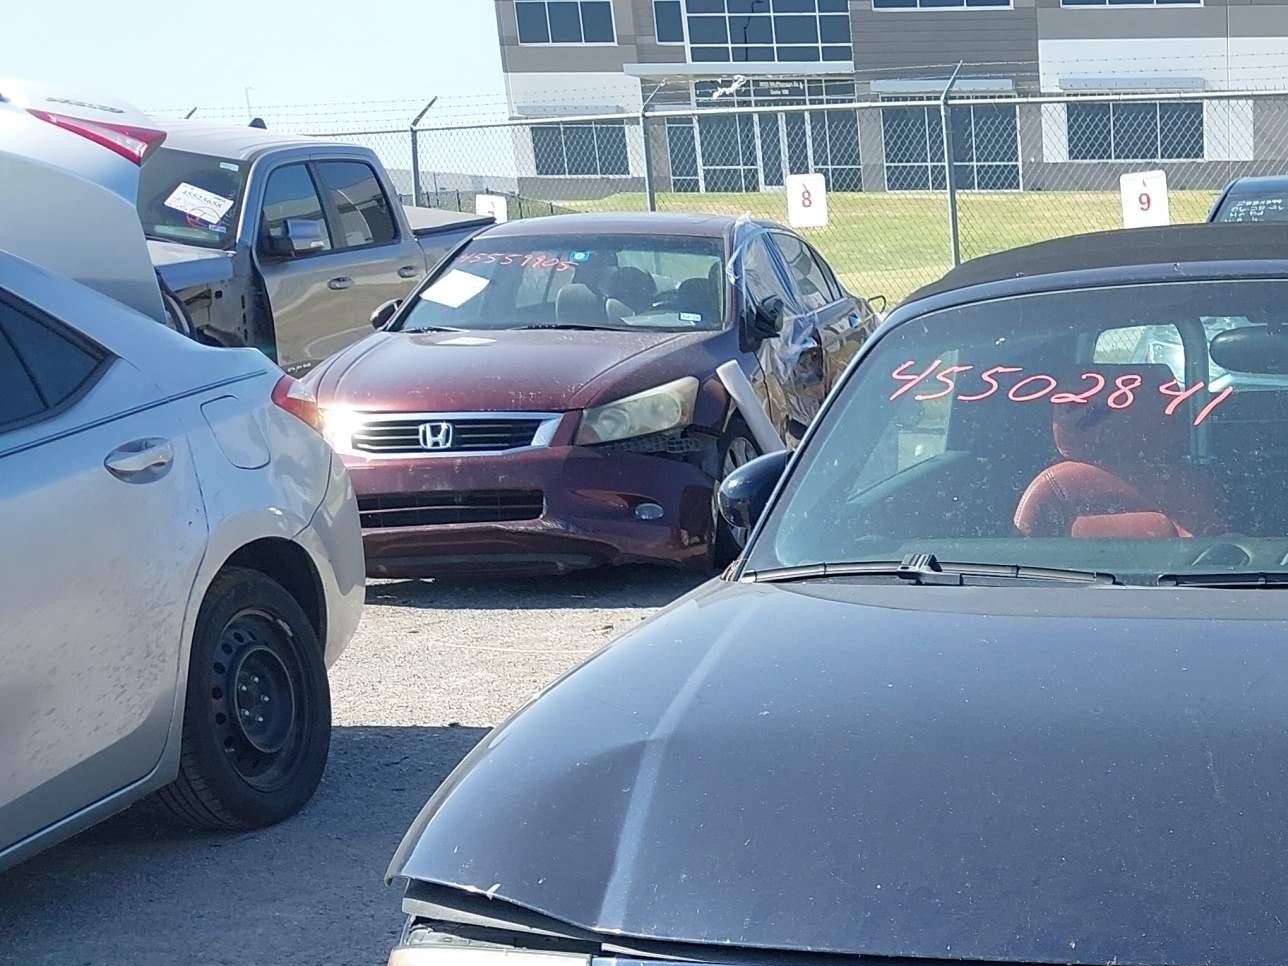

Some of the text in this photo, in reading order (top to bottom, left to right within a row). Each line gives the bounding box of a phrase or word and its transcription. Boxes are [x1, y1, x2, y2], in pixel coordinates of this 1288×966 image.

[801, 189, 813, 208] 8
[1138, 192, 1151, 212] 9
[890, 358, 1233, 426] 45502841
